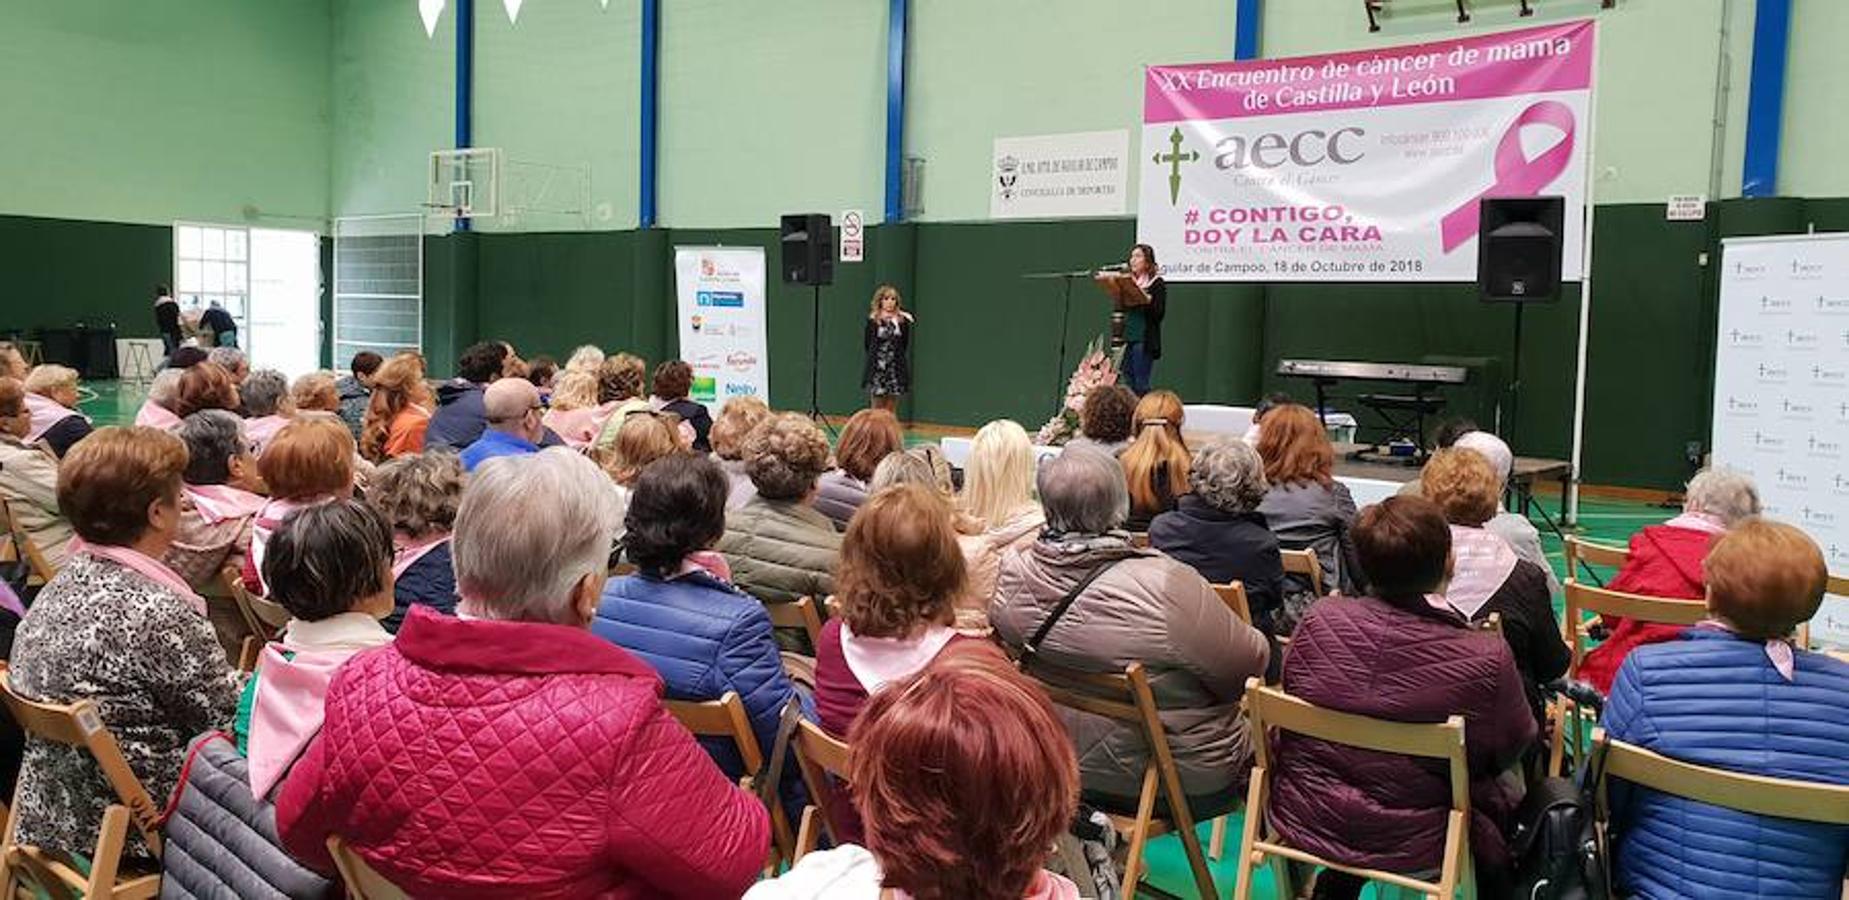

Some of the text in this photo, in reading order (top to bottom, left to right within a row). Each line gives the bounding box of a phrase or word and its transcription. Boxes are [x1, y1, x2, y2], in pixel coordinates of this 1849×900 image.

[1160, 37, 1571, 91] XX Encuentro de cáncer de mama
[1243, 72, 1456, 111] de Castilla y León
[1214, 126, 1365, 171] aecc
[1184, 204, 1354, 225] # CONTIGO,
[1184, 225, 1382, 244] DOY LA CARA
[1154, 260, 1423, 274] guilar de Campoo, 18 de Octubre de 2018
